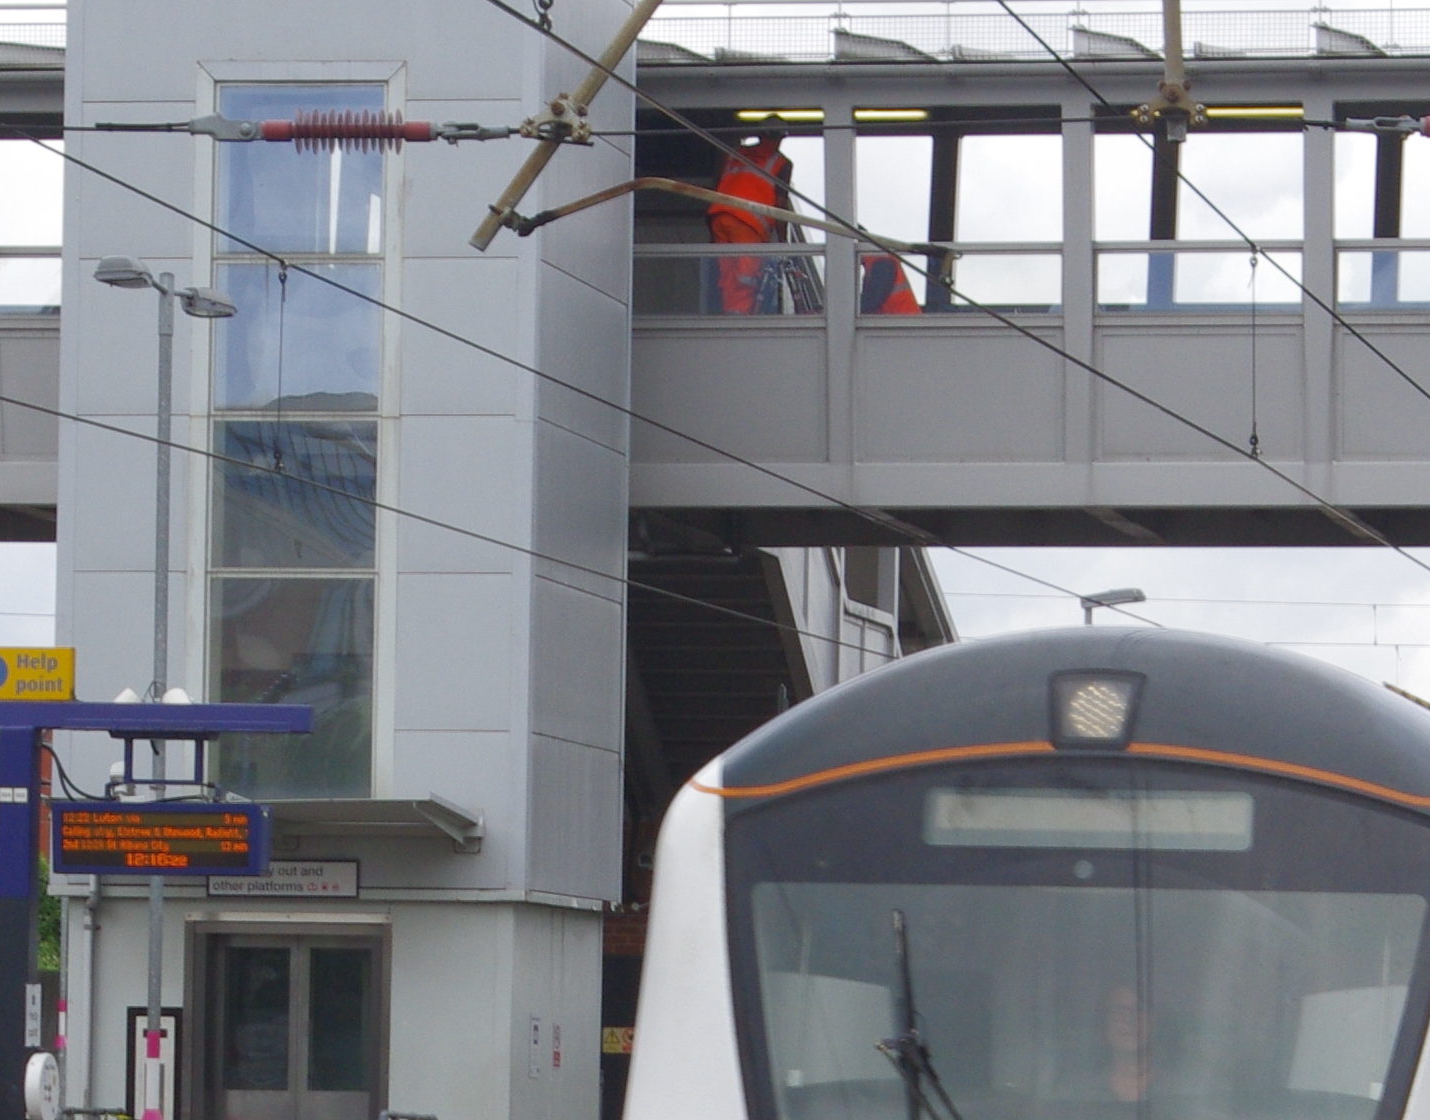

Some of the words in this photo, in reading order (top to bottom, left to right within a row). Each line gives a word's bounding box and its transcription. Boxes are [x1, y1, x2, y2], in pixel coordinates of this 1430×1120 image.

[17, 653, 58, 673] Help
[16, 675, 64, 696] point
[277, 866, 297, 877] out
[300, 866, 324, 877] and
[212, 881, 244, 892] other
[246, 881, 304, 893] platforms
